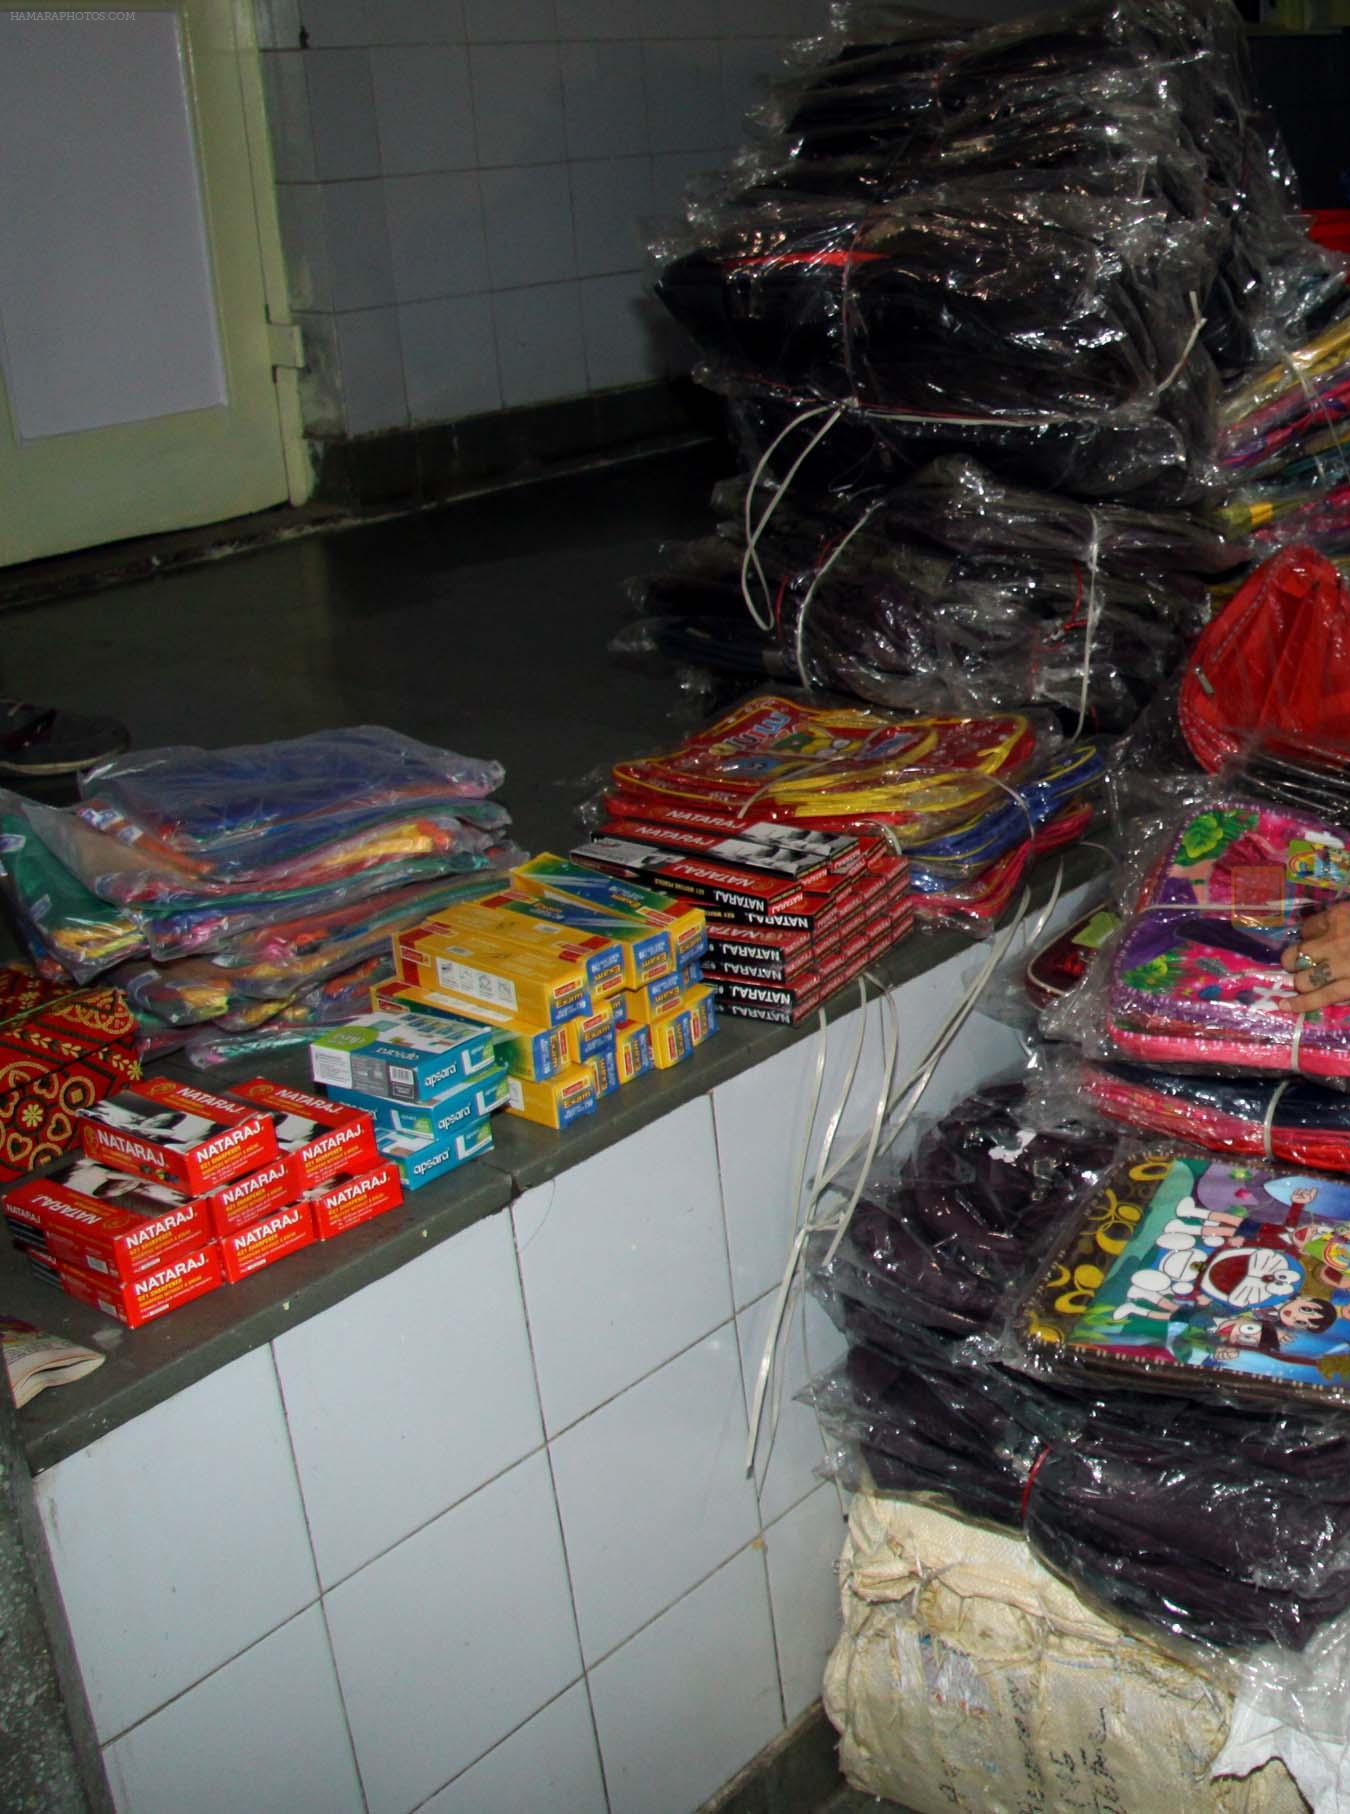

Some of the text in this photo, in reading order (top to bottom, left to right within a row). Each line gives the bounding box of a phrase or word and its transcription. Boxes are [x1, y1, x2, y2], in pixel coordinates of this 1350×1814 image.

[667, 809, 746, 829] NATARAJ
[635, 826, 715, 846] NATARAJ
[673, 864, 755, 887] NATARAJ
[716, 889, 764, 911] NATARAJ
[749, 913, 809, 928] NATARAJ
[722, 944, 780, 962] NATARAJ
[723, 962, 782, 981] NATARAJ
[732, 986, 790, 1006] NATARAJ
[731, 1004, 790, 1024] NATARAJ
[424, 1064, 456, 1087] apsara
[177, 1087, 243, 1113] NATARAJ
[275, 1089, 343, 1114] NATARAJ
[438, 1105, 471, 1129] apsara
[97, 1129, 165, 1168] NATARAJ
[196, 1121, 262, 1163] NATARAJ
[302, 1124, 362, 1162] NATARAJ
[413, 1151, 449, 1175] apsara
[222, 1165, 286, 1205] NATARAJ
[326, 1172, 387, 1209] NATARAJ
[32, 1195, 102, 1224] NATARAJ
[126, 1207, 194, 1249] NATARAJ
[234, 1210, 300, 1249] NATARAJ
[135, 1253, 206, 1296] NATARAJ
